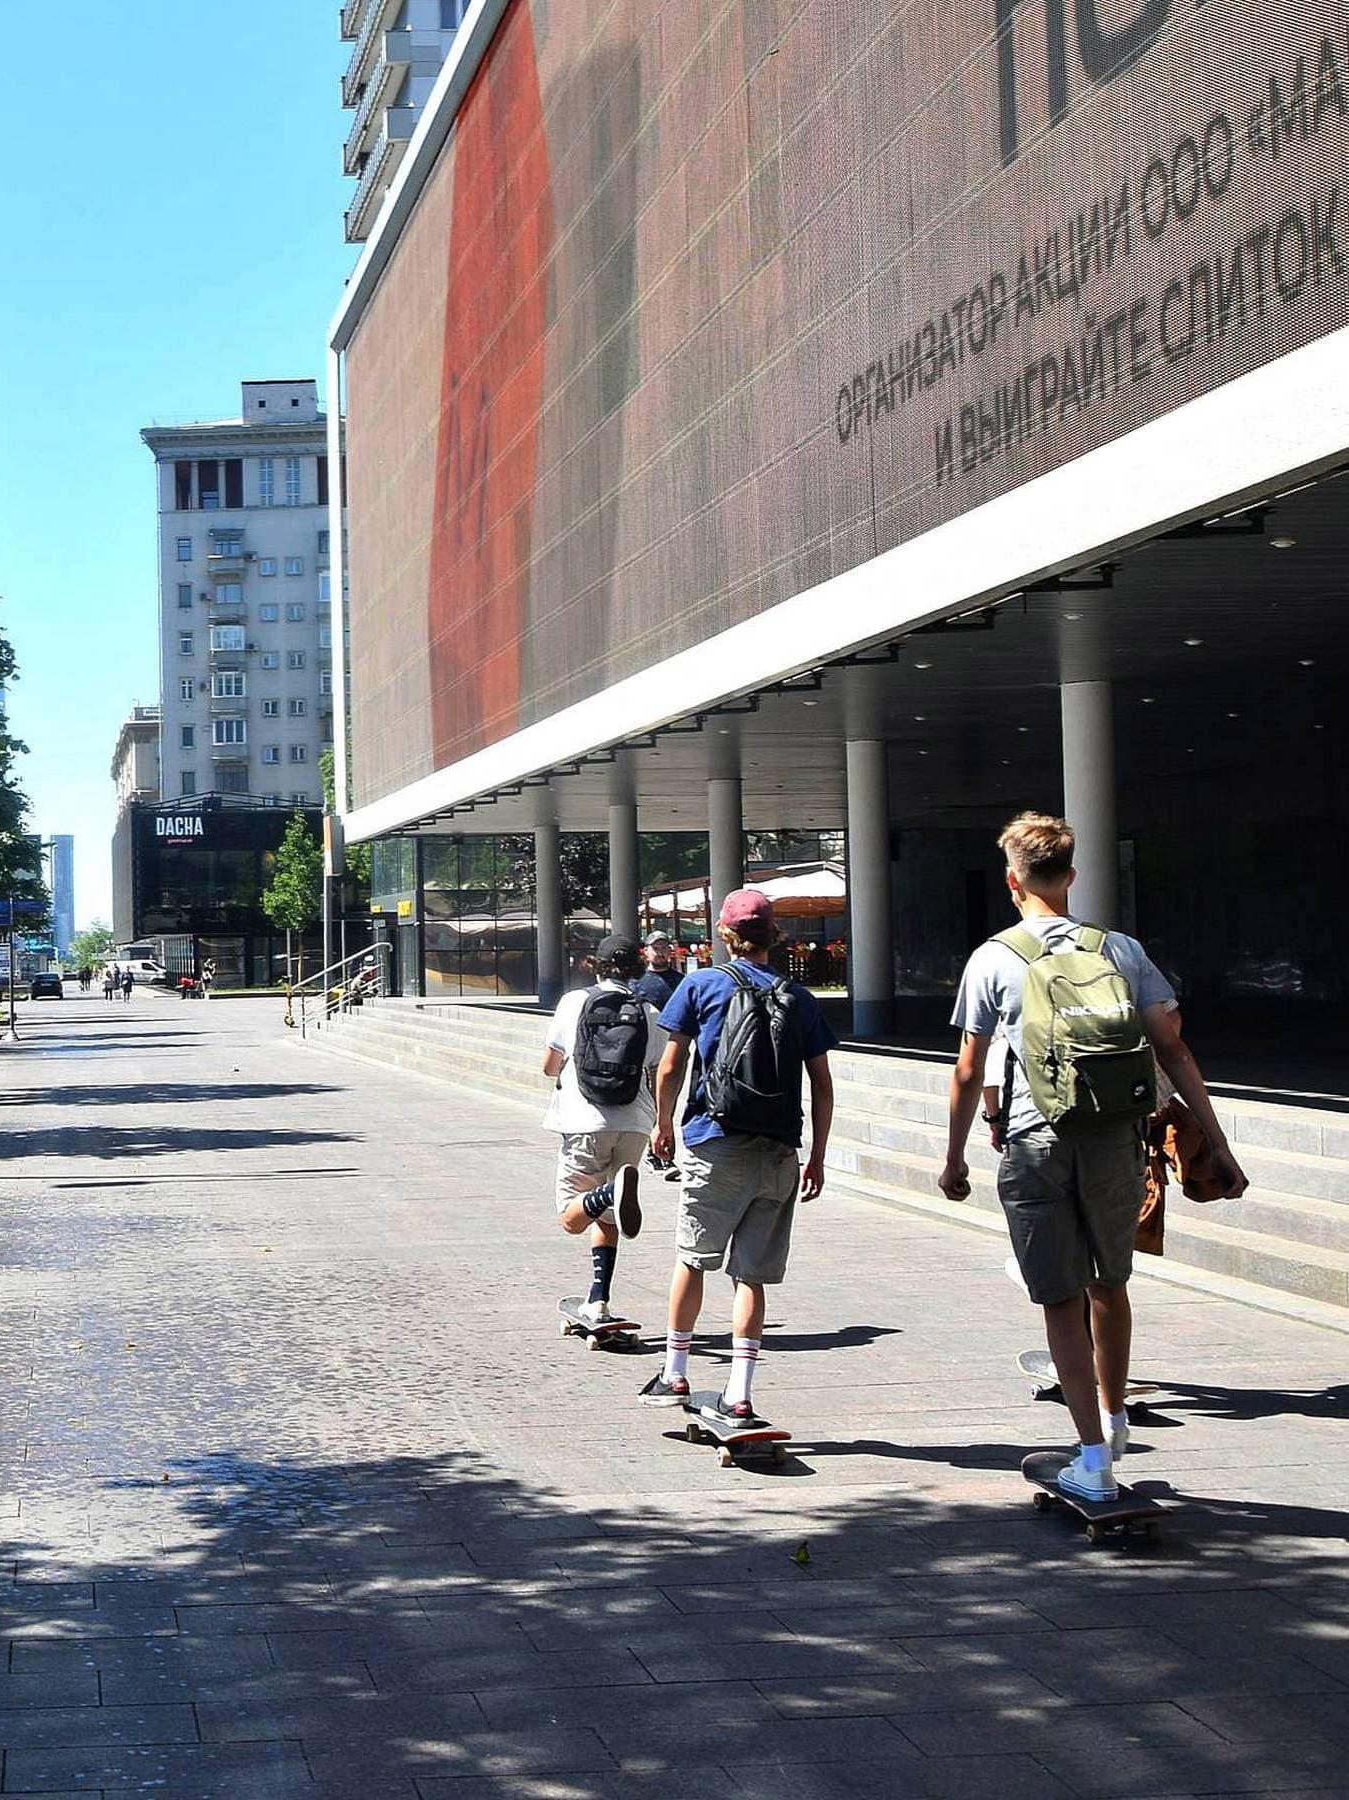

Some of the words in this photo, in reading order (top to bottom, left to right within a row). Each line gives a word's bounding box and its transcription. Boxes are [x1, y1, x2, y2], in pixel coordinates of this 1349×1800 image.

[835, 270, 1008, 446] ОРГАНИЗАТОР
[1014, 177, 1132, 327] АКЦИИ
[1139, 111, 1234, 240] ООО
[1246, 32, 1349, 160] «МА
[934, 418, 956, 487] И
[957, 300, 1152, 473] ВЫИГРАЙТЕ
[1158, 185, 1347, 364] СЛИТОК
[156, 817, 203, 836] DACHA
